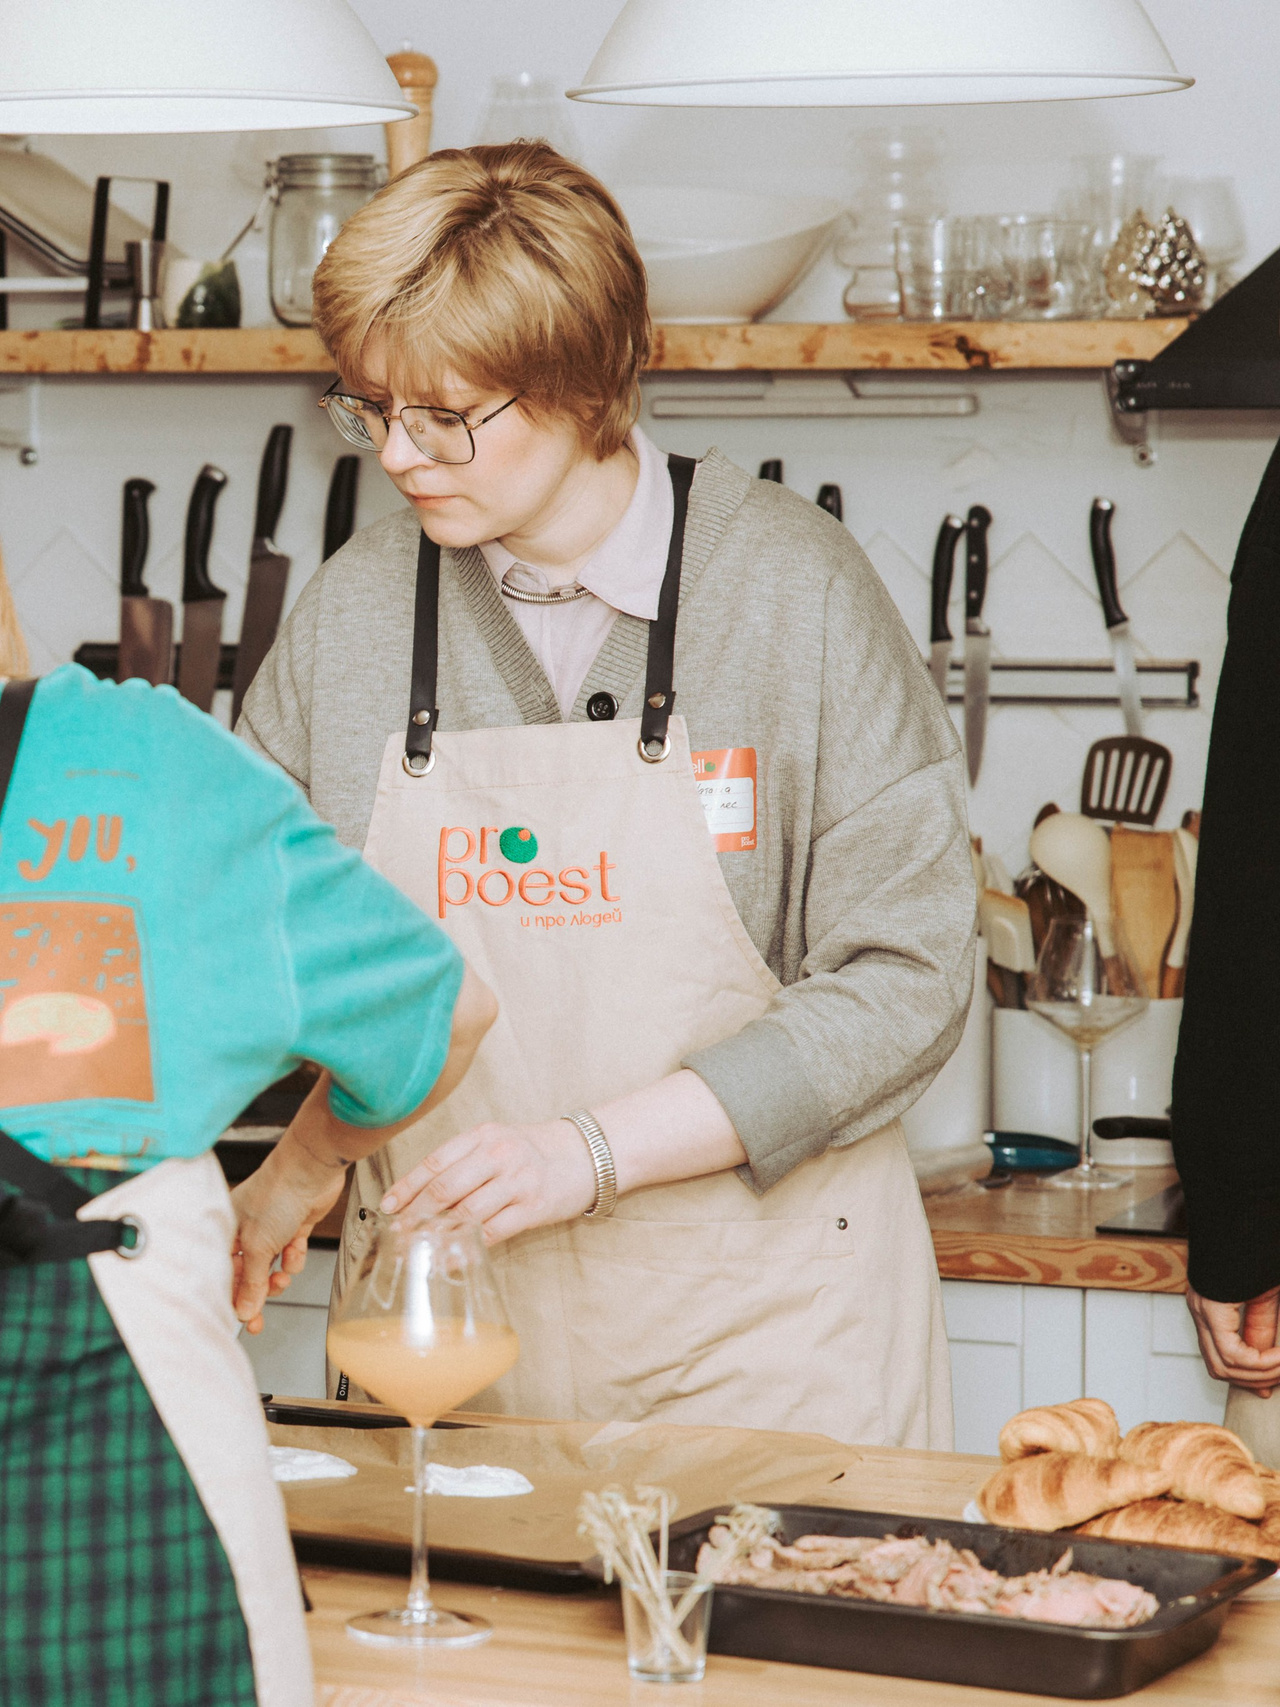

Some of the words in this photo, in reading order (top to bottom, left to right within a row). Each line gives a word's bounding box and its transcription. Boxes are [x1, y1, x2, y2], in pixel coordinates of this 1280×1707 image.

[18, 813, 136, 882] you,
[438, 851, 621, 919] poest
[535, 915, 566, 930] про
